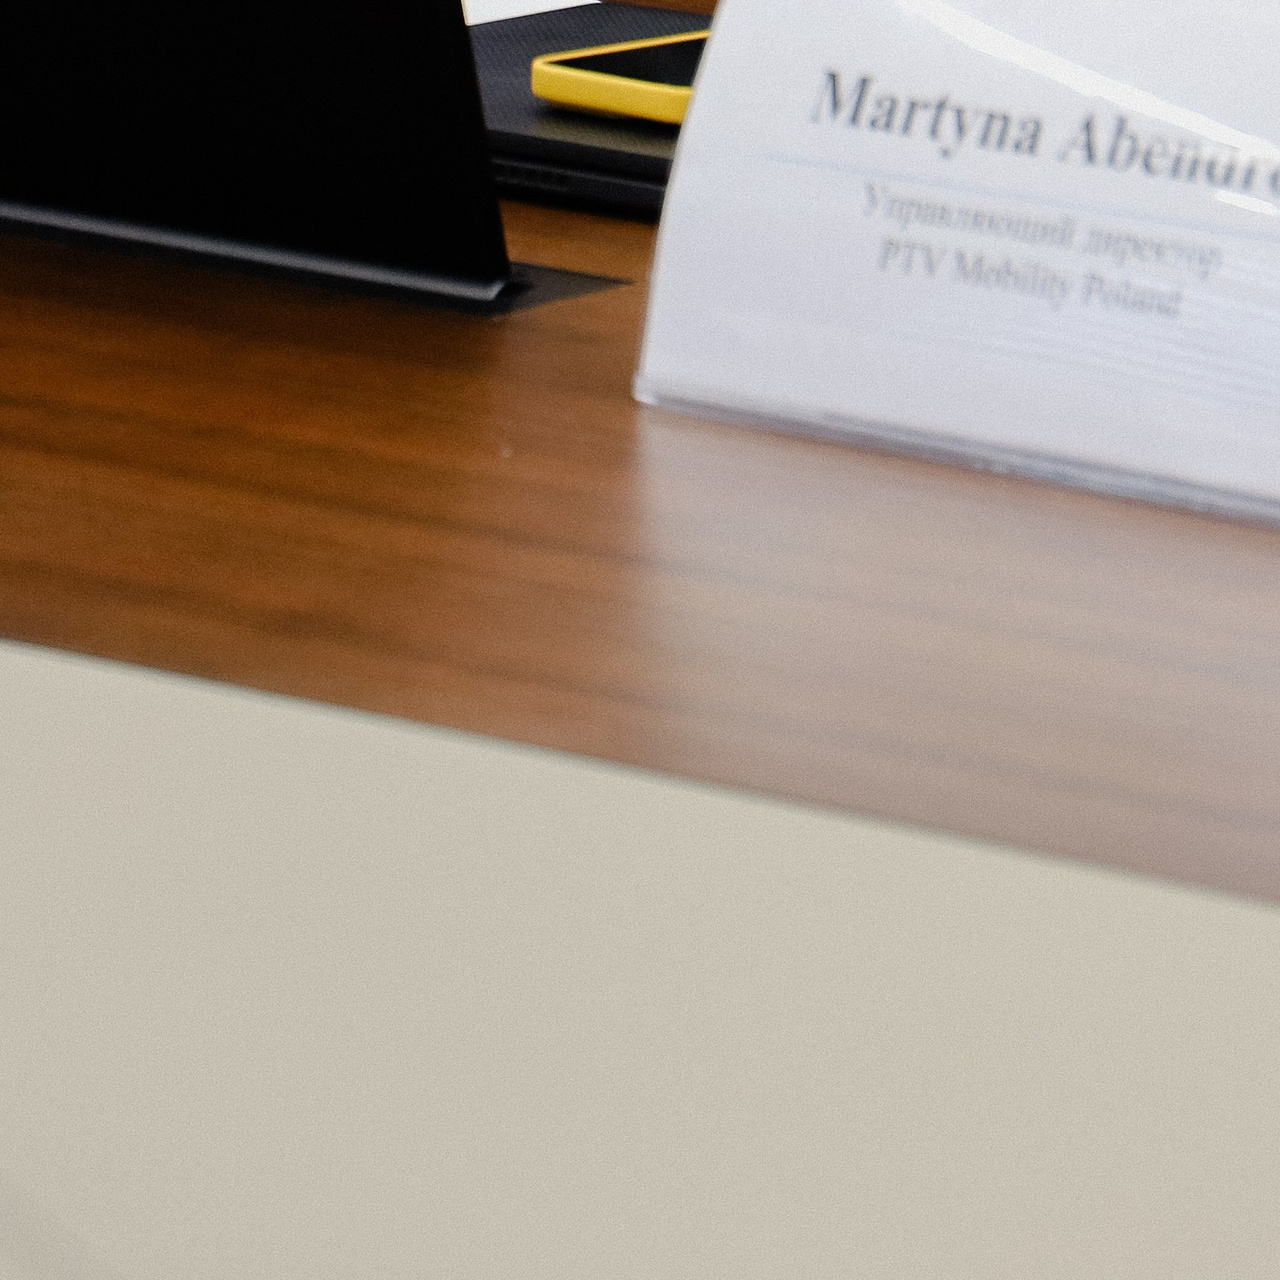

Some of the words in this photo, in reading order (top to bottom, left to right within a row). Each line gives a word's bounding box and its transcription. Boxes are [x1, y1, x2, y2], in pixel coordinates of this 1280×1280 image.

[811, 68, 1042, 159] Martyna
[876, 236, 948, 278] PTV
[951, 248, 1071, 312] Mobility
[1080, 272, 1185, 318] Poland
